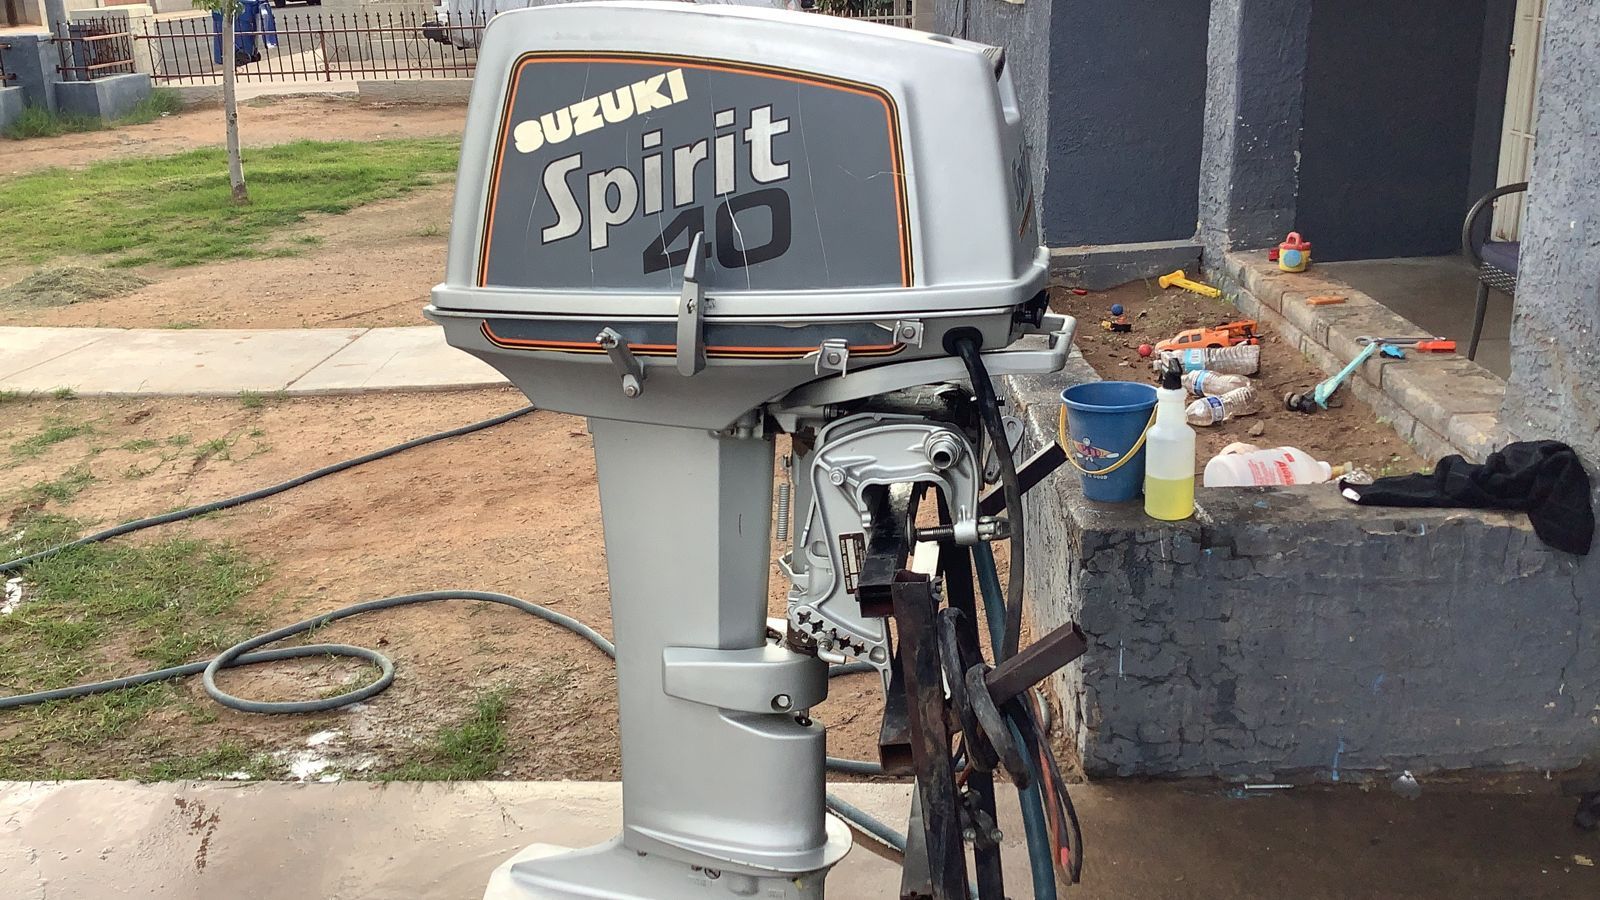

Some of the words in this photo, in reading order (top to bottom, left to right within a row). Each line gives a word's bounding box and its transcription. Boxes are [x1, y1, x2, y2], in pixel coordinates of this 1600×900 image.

[513, 68, 689, 153] SUZUKI
[541, 103, 790, 251] Spirit
[643, 187, 791, 274] 40
